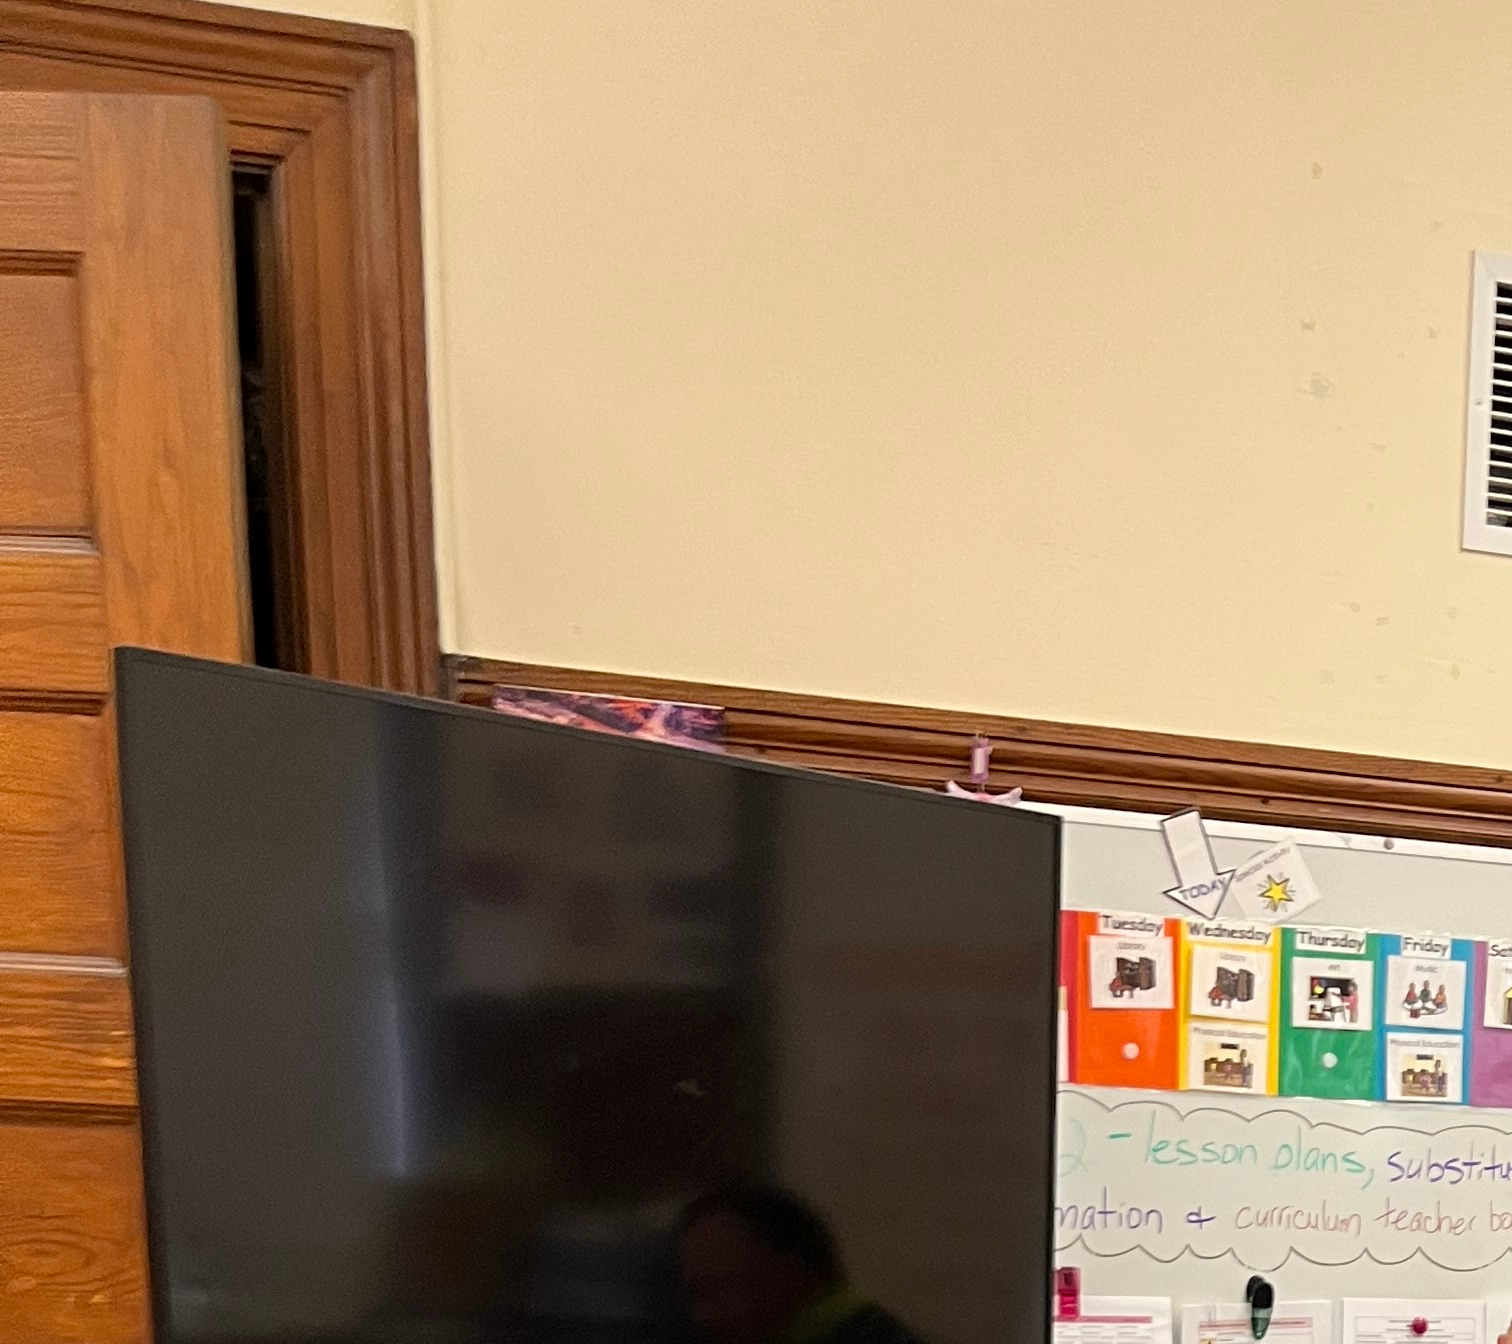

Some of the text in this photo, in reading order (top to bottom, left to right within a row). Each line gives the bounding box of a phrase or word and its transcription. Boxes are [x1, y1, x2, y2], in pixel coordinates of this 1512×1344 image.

[1179, 878, 1229, 901] TODAY
[1101, 915, 1164, 936] Tuesday
[1188, 922, 1272, 945] Wednesday
[1300, 932, 1365, 952] Thursday
[1404, 937, 1450, 958] Friday
[1145, 1109, 1257, 1165] lesson
[1236, 1200, 1363, 1237] curriculum
[1374, 1197, 1477, 1237] teacher
